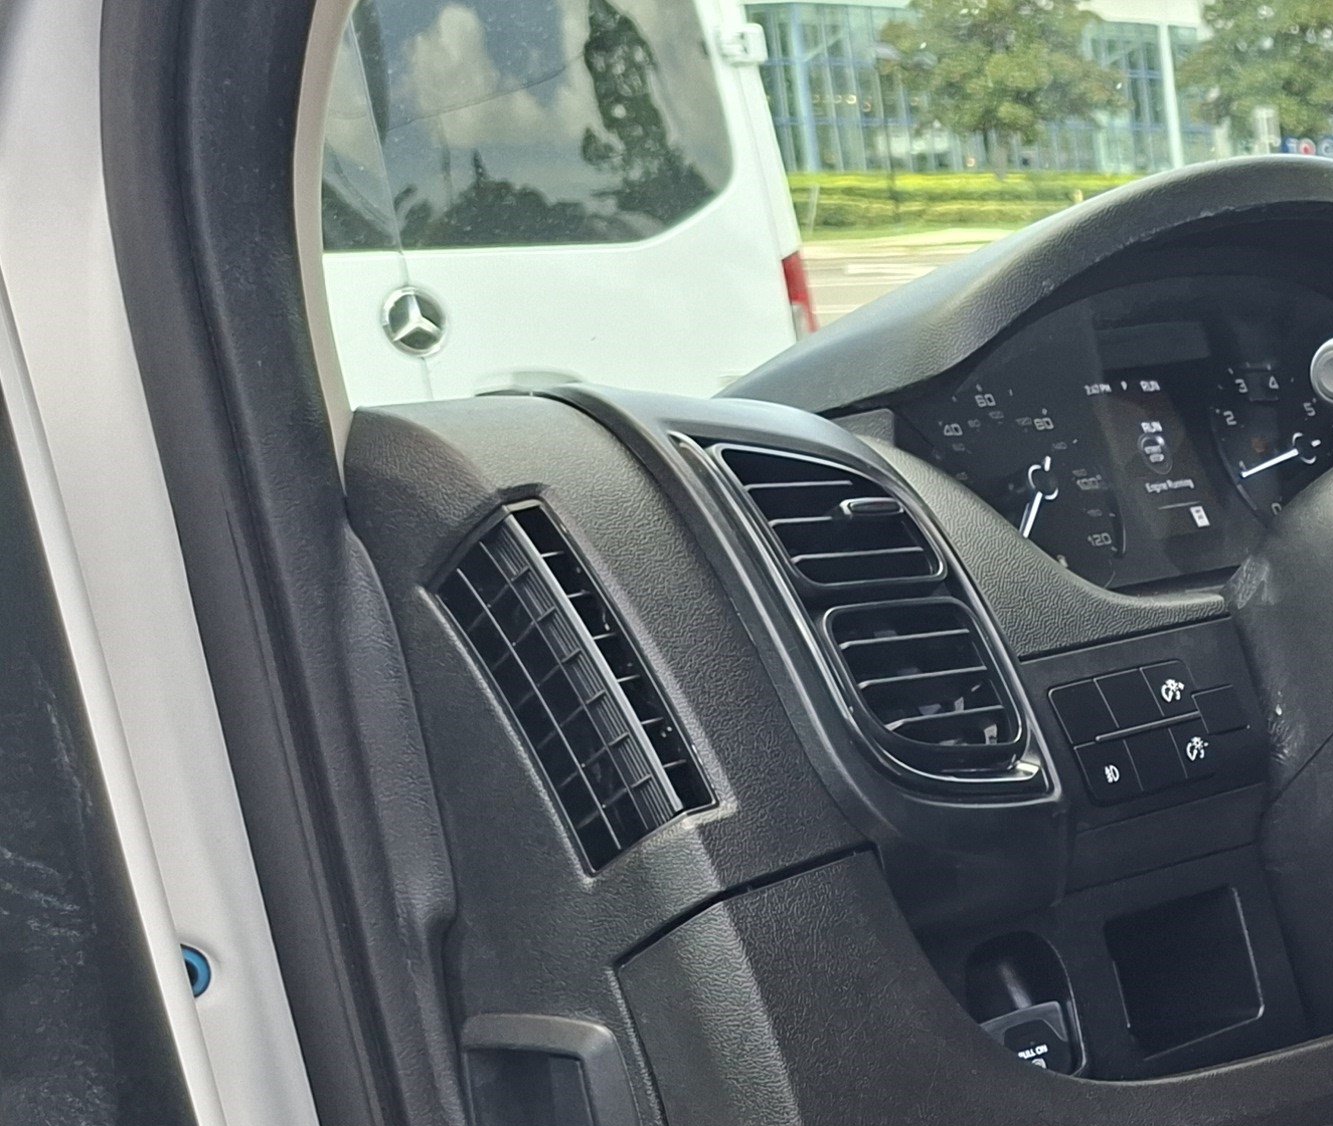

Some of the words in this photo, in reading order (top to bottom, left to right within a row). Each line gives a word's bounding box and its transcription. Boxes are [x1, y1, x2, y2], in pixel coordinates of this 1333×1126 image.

[1235, 378, 1248, 393] 3
[1268, 376, 1279, 389] 4
[975, 393, 996, 407] 60
[1303, 402, 1316, 416] 5
[1223, 410, 1237, 426] 2
[943, 423, 963, 436] 40
[1141, 421, 1162, 433] RUN
[1087, 532, 1112, 546] 120
